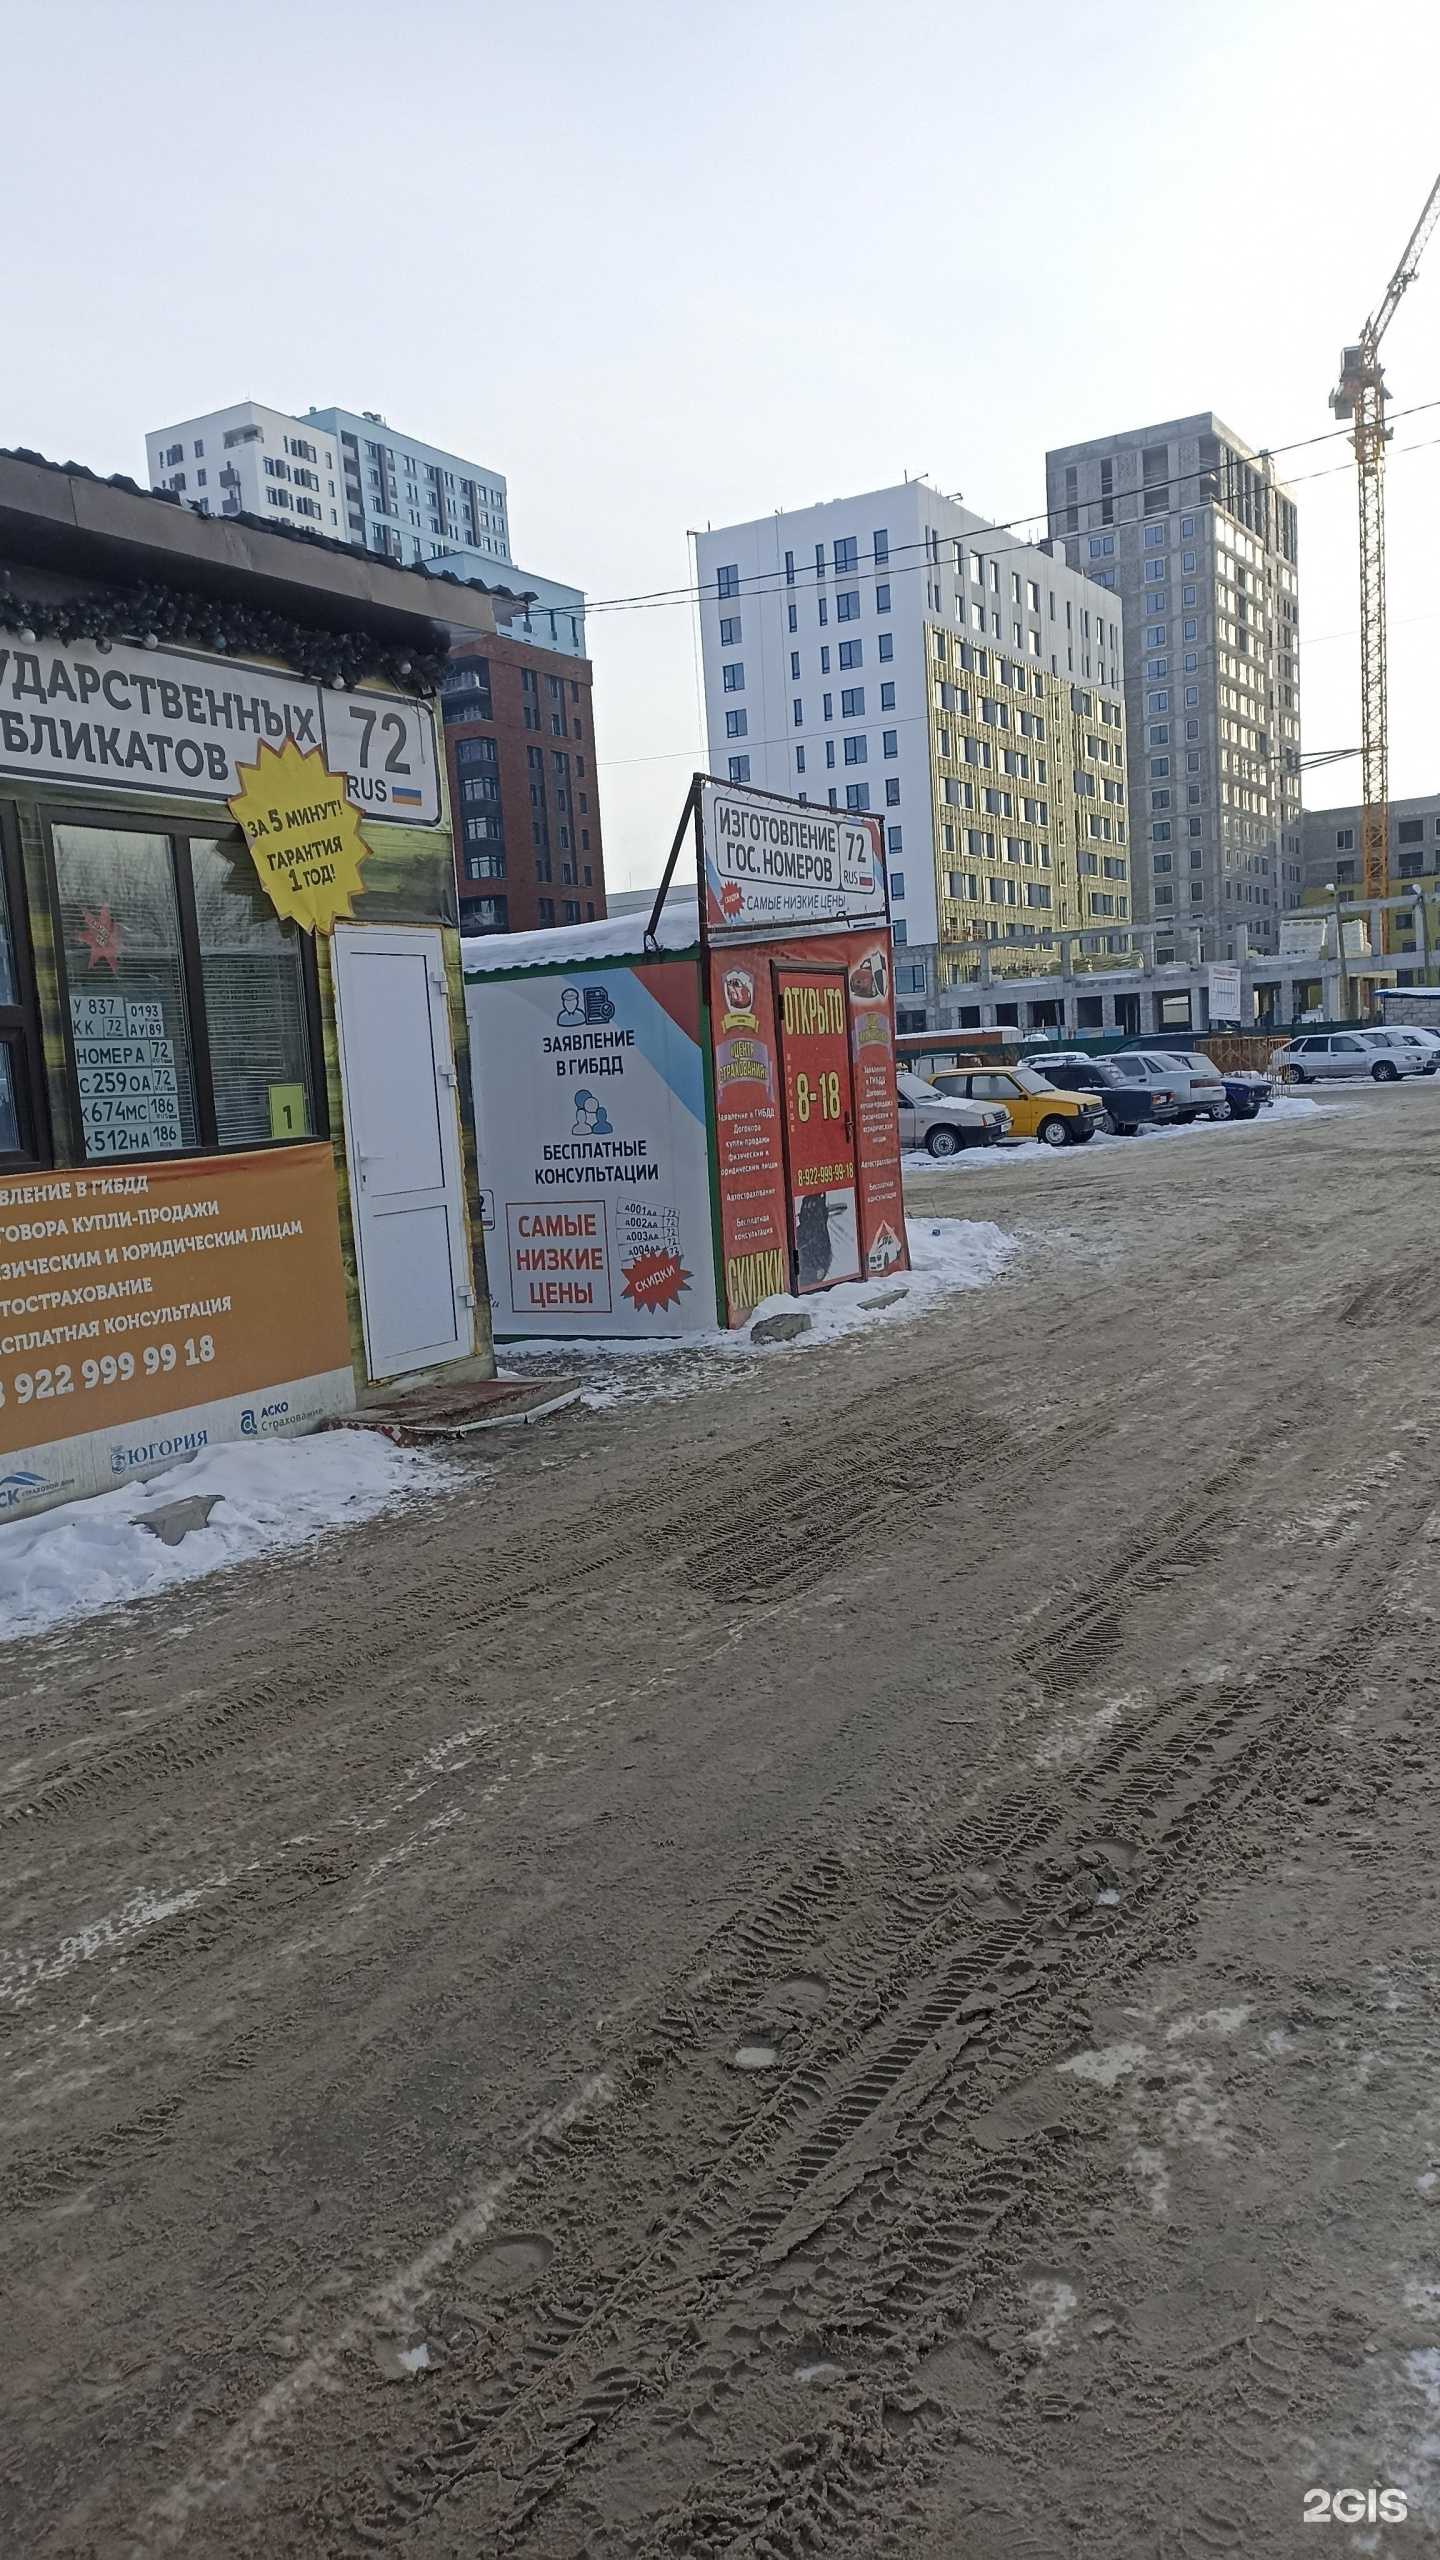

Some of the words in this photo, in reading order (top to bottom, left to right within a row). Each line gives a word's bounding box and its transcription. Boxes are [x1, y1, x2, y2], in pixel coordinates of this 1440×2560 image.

[0, 709, 228, 781] БЛИКАТОВ
[349, 706, 411, 775] 72
[347, 775, 387, 802] RUS
[248, 820, 270, 838] ЗА
[268, 809, 283, 832] 5
[285, 799, 343, 829] МИНУТ!
[719, 806, 836, 853] ИЗГОТОВЛЕНИЕ
[267, 836, 343, 872] ГАРАНТИЯ
[846, 832, 867, 863] 72
[727, 842, 760, 874] ГОС.
[763, 848, 833, 883] НОМЕРОВ
[289, 868, 303, 892] 1
[304, 864, 336, 887] ГОД!
[843, 870, 858, 885] RUS
[746, 895, 782, 911] САМЫЕ
[783, 895, 818, 909] НИЗКИЕ
[820, 894, 846, 910] ЦЕНЫ
[88, 999, 115, 1015] 837
[784, 986, 844, 1036] ОТКРЫТО
[108, 1020, 121, 1032] 72
[151, 1042, 168, 1058] 72
[543, 1030, 635, 1053] ЗАЯВЛЕНИЕ
[154, 1070, 171, 1085] 72
[556, 1061, 566, 1076] В
[569, 1056, 624, 1076] ГИБДД
[151, 1098, 174, 1113] 186
[796, 1072, 841, 1122] 8-18
[283, 1105, 292, 1129] 1
[153, 1126, 177, 1142] 186
[543, 1140, 647, 1160] БЕСПЛАТНЫЕ
[535, 1164, 659, 1184] КОНСУЛЬТАЦИИ
[797, 1162, 854, 1186] 8-922-999-99-18
[0, 1182, 71, 1206] ВЛЕНИЕ
[76, 1182, 87, 1197] В
[92, 1176, 149, 1195] ГИБДД
[72, 1201, 220, 1234] КУПЛИ-ПРОДАЖИ
[518, 1214, 596, 1238] САМЫЕ
[0, 1250, 102, 1281] ЗИЧЕСКИМ
[105, 1248, 118, 1264] И
[123, 1228, 248, 1261] ЮРИДИЧЕСКИМ
[250, 1220, 303, 1242] ЛИЦАМ
[516, 1248, 603, 1270] НИЗКИЕ
[634, 1265, 675, 1293] СКИДКИ
[728, 1249, 784, 1309] СКИДКИ
[0, 1277, 152, 1317] ТОСТРАХОВАНИЕ
[529, 1282, 593, 1308] ЦЕНЫ
[0, 1320, 100, 1356] СПЛАТНАЯ
[104, 1296, 232, 1334] КОНСУЛЬТАЦИЯ
[15, 1364, 75, 1404] 922
[82, 1351, 135, 1389] 999
[143, 1343, 176, 1376] 99
[185, 1335, 215, 1366] 18
[261, 1402, 288, 1418] АСКО
[128, 1430, 208, 1464] ЮГОРИЯ
